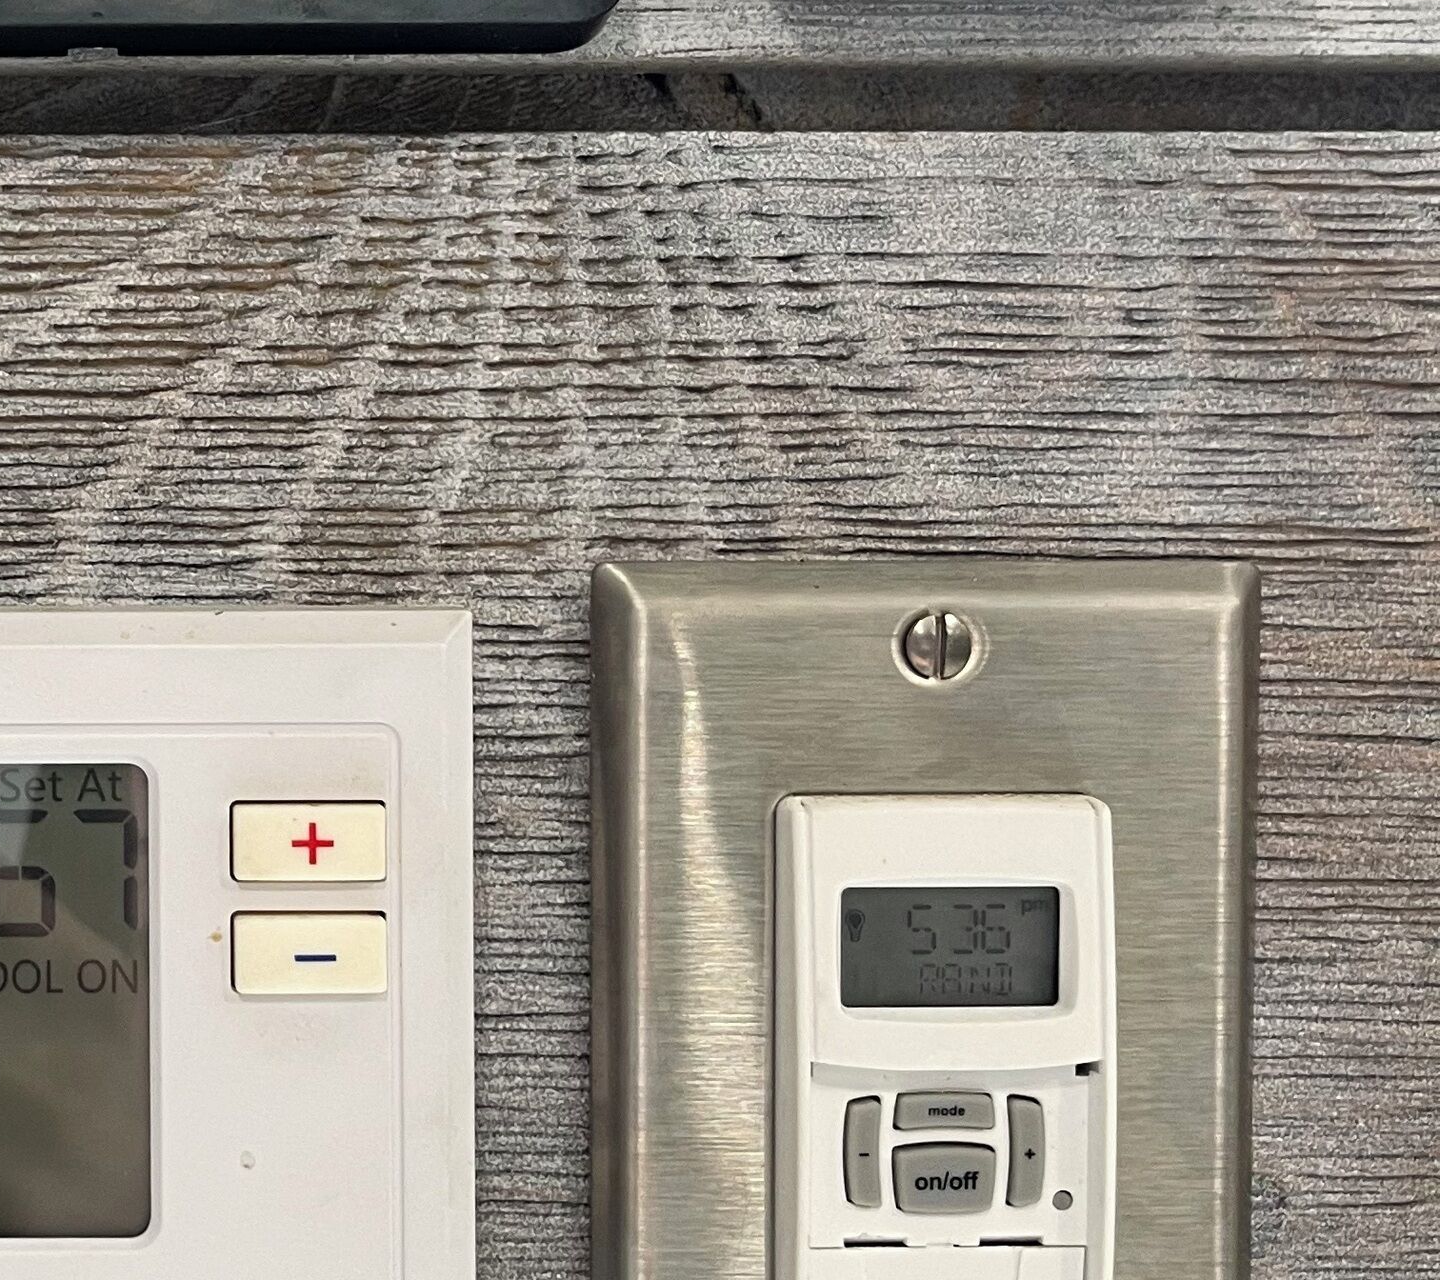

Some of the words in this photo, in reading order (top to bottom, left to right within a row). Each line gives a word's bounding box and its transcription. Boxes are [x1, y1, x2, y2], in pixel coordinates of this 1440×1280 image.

[76, 767, 123, 803] At
[76, 958, 139, 994] ON
[927, 1105, 966, 1117] mode
[914, 1170, 980, 1191] on/off
